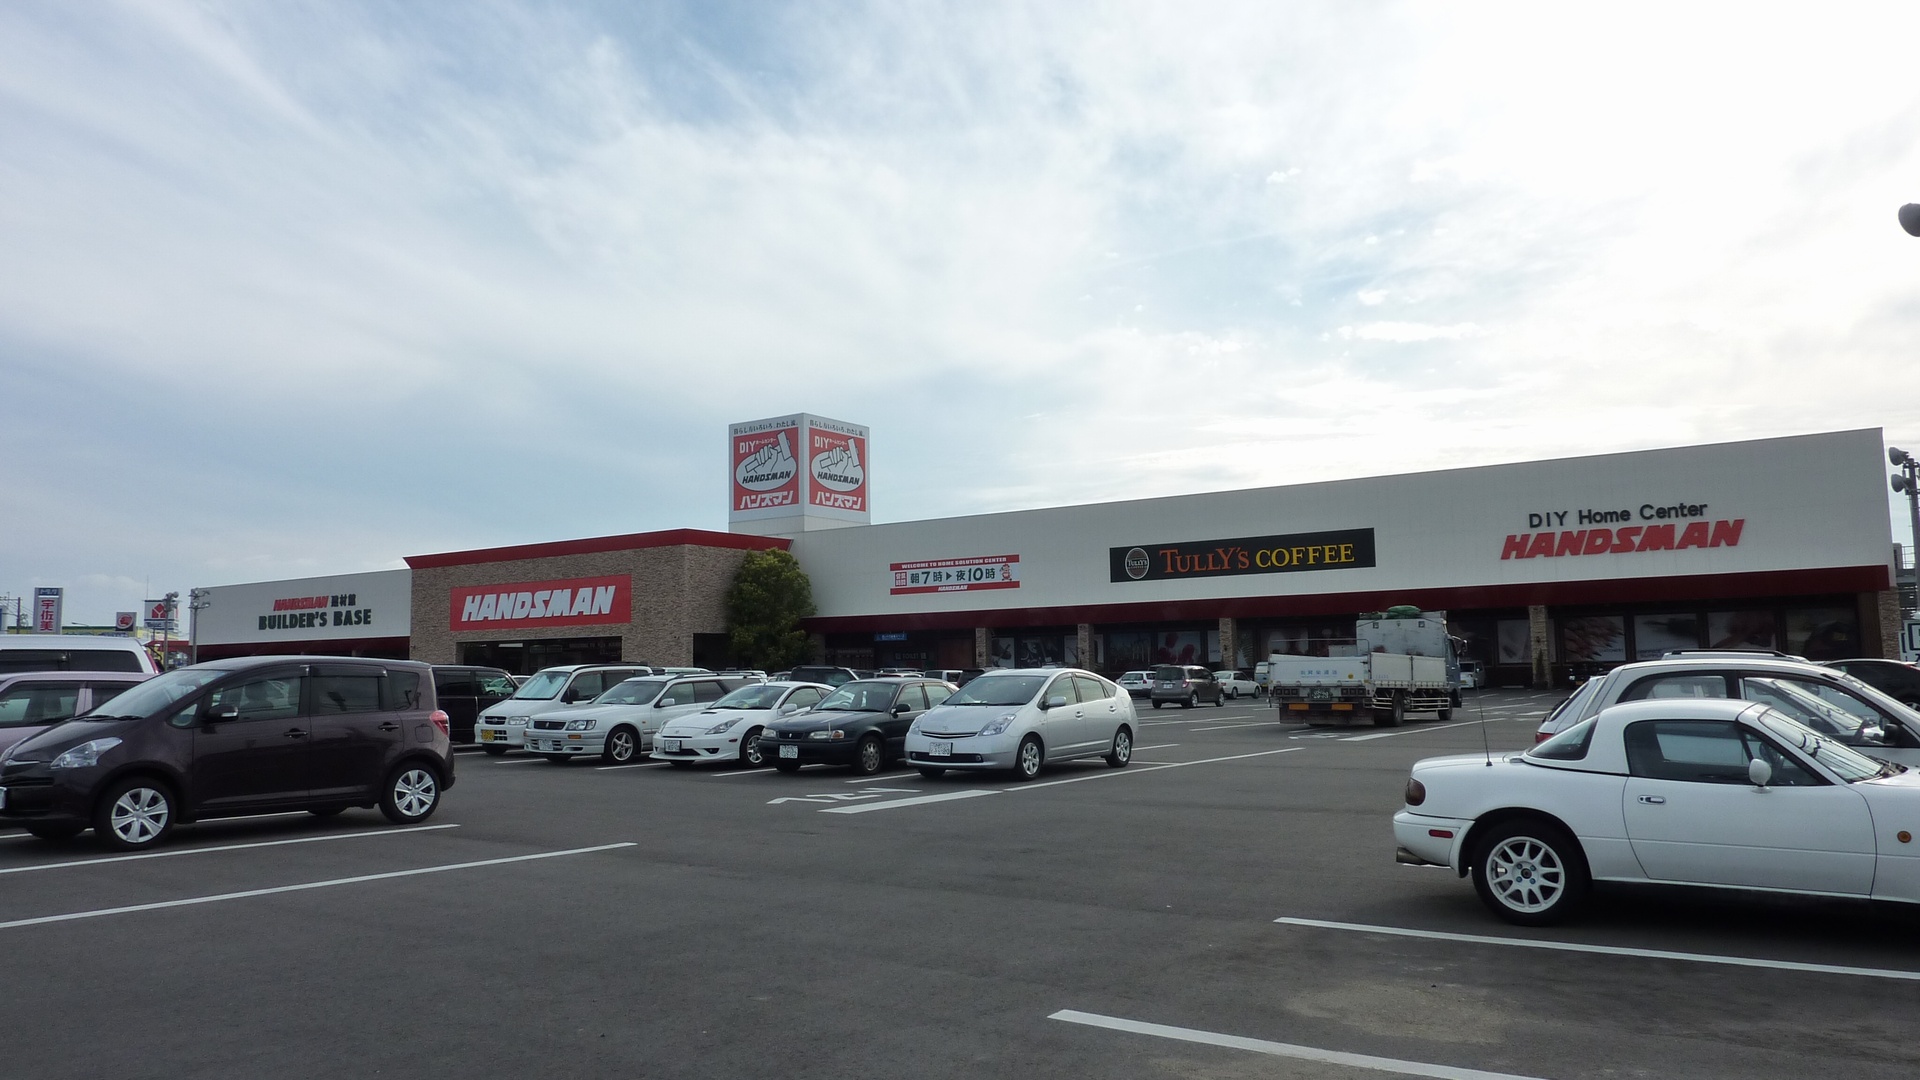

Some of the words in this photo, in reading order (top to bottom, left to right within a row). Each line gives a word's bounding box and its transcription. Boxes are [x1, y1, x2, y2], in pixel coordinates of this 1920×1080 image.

[740, 441, 756, 454] DIY
[815, 435, 829, 448] DIY
[742, 470, 791, 484] HANDSMAN
[817, 471, 860, 486] HANDSMAN
[740, 490, 794, 509] ハンズマン
[816, 491, 862, 509] ハンズマン
[1528, 510, 1569, 529] DIY
[1579, 508, 1631, 525] Home
[1639, 502, 1708, 521] Center
[1500, 518, 1745, 560] HANDSMAN
[955, 558, 983, 566] SOLUTION
[1159, 546, 1250, 573] TULLY'S
[1255, 543, 1355, 568] COFFEE
[273, 595, 329, 611] HANDSMAN
[461, 585, 616, 622] HANDSMAN
[258, 611, 327, 630] BUILDER'S
[333, 608, 372, 627] BASE
